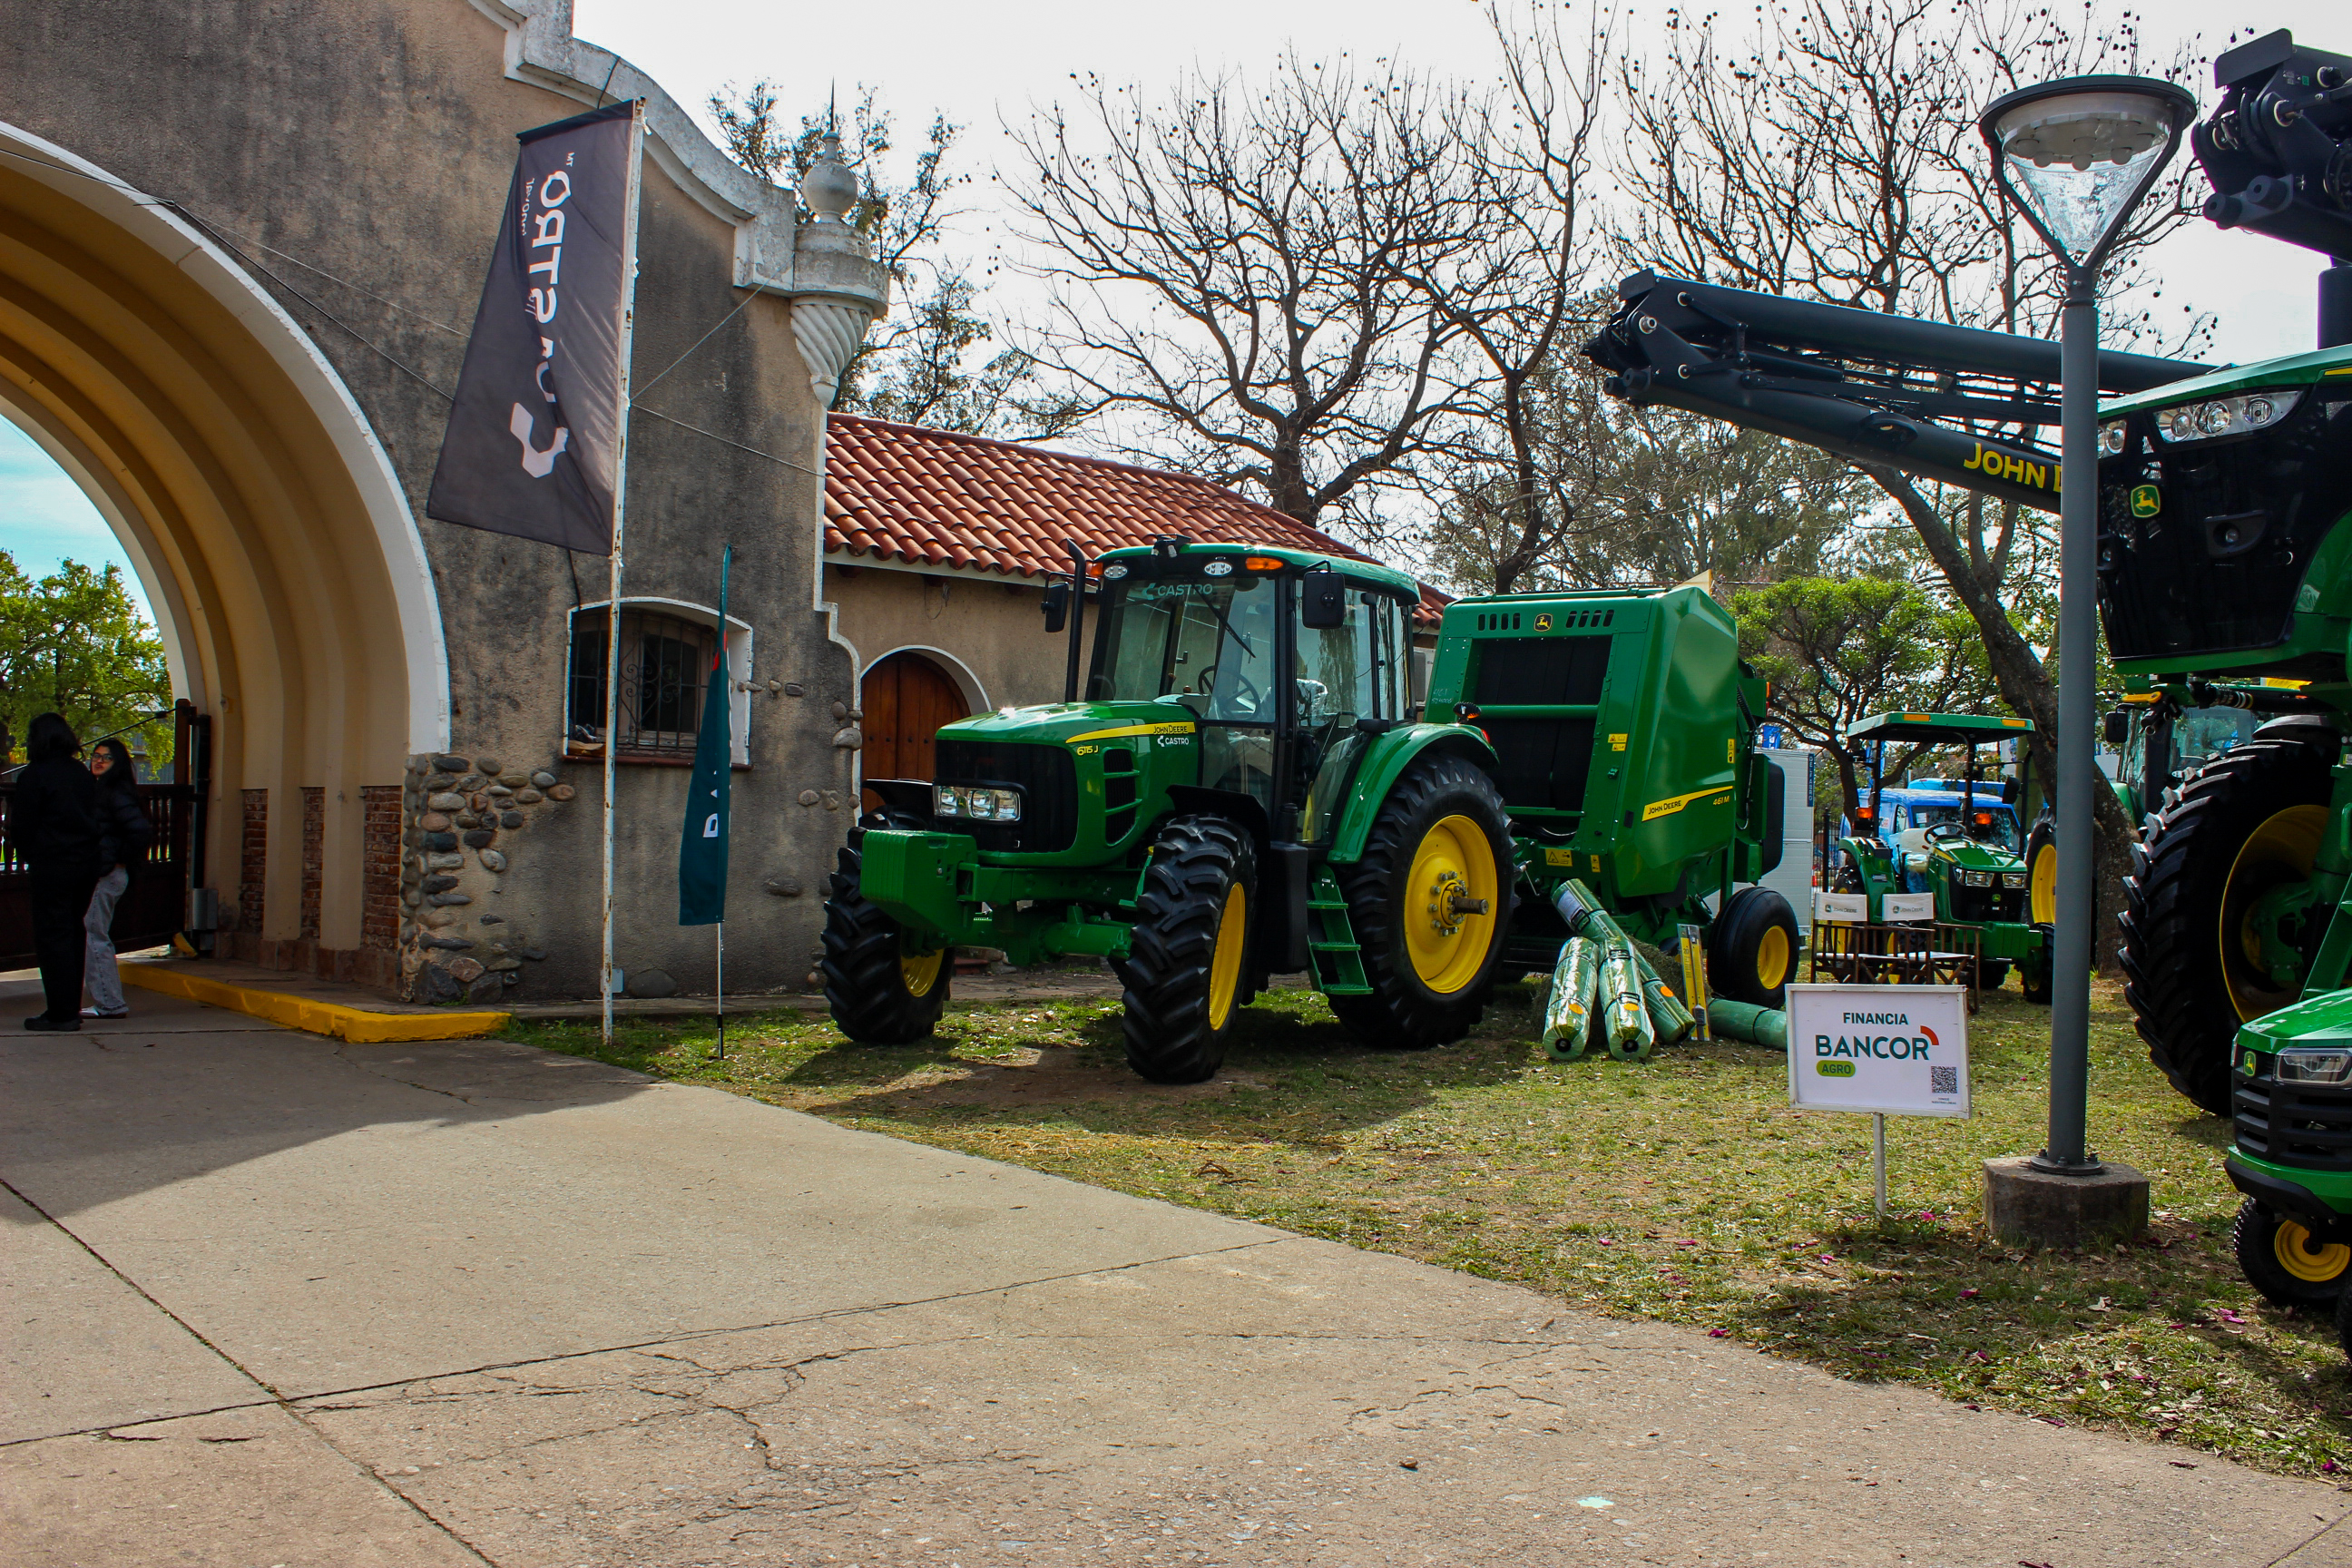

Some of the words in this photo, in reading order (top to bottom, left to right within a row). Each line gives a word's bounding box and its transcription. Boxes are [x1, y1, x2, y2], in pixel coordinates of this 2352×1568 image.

[1964, 442, 2045, 488] JOHN
[1157, 583, 1213, 596] CASTRO
[1153, 726, 1169, 734] JOHN
[1169, 724, 1188, 733] DEERE
[1165, 737, 1190, 745] CASTRO
[1648, 804, 1663, 815] JOHN
[1663, 799, 1681, 810] DEERE
[1843, 1012, 1908, 1025] FINANCIA
[1816, 1034, 1929, 1061] BANCOR
[1821, 1063, 1851, 1074] AGRO
